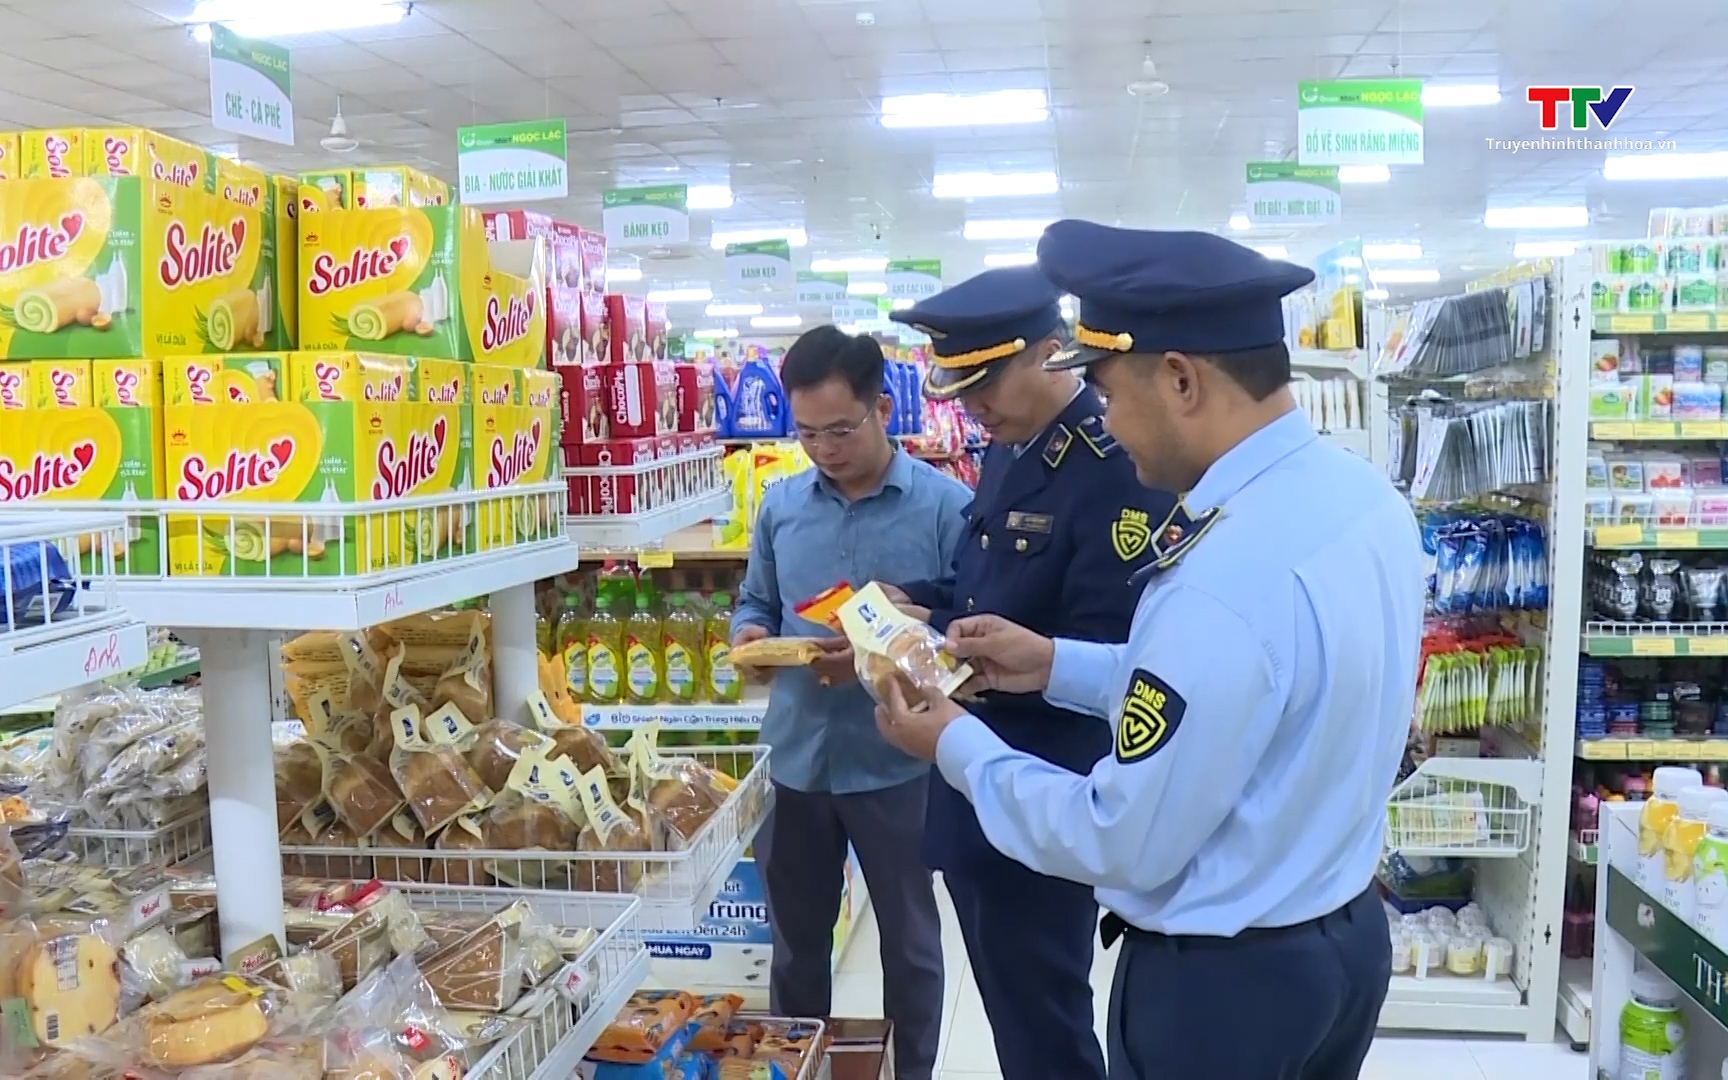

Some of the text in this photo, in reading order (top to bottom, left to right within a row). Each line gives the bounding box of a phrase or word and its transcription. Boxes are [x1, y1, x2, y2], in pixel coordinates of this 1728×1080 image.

[264, 102, 282, 130] PHÊ
[1335, 133, 1358, 152] SINH
[1360, 129, 1386, 152] RĂNG
[1388, 128, 1419, 157] MIỆNG
[464, 175, 480, 193] BIA
[489, 168, 515, 192] NƯỚC
[517, 164, 536, 190] GIẢI
[539, 165, 562, 188] KHÁT
[623, 222, 669, 239] BÁNH KẸO
[161, 222, 235, 287] Solite
[309, 248, 394, 294] Solite
[482, 296, 529, 351] Solite
[177, 452, 277, 501] Solite
[373, 433, 437, 501] Solite
[487, 433, 535, 489] Solite
[1121, 508, 1149, 524] DMS
[1134, 679, 1167, 710] DMS
[674, 946, 706, 956] NGAY
[1692, 952, 1722, 1006] TH
